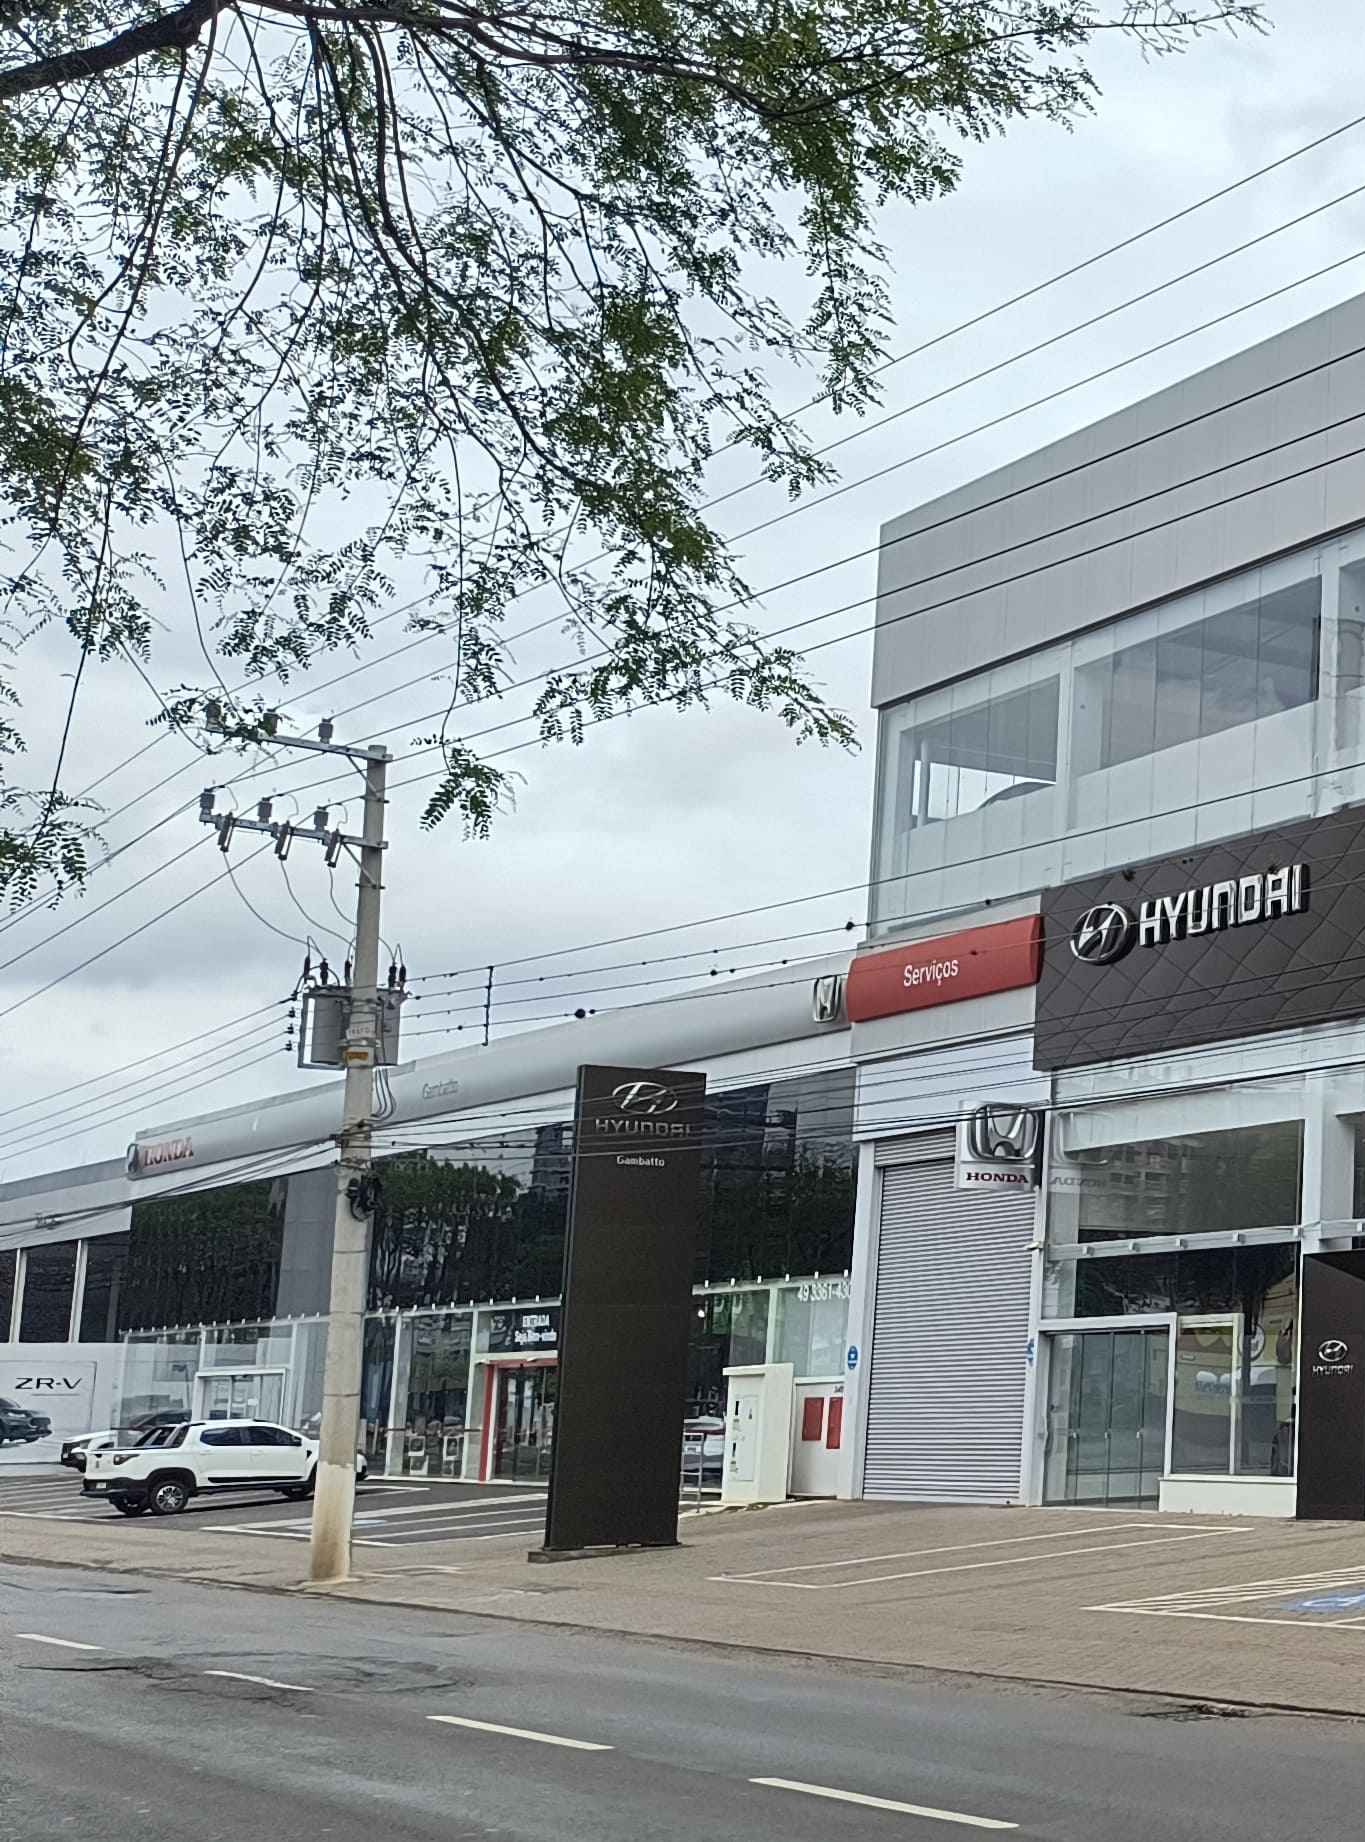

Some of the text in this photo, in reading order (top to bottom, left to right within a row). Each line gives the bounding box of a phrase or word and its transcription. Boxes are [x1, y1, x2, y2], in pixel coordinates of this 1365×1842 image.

[1138, 863, 1310, 948] HYUNDAI
[903, 959, 959, 987] Serviços
[595, 1118, 691, 1138] HYUNDAI
[143, 1135, 194, 1167] HONDA
[616, 1155, 665, 1167] Gambatto
[966, 1171, 1029, 1184] HONDA
[1312, 1365, 1353, 1376] HYUNDAI
[15, 1377, 82, 1390] ZR-V
